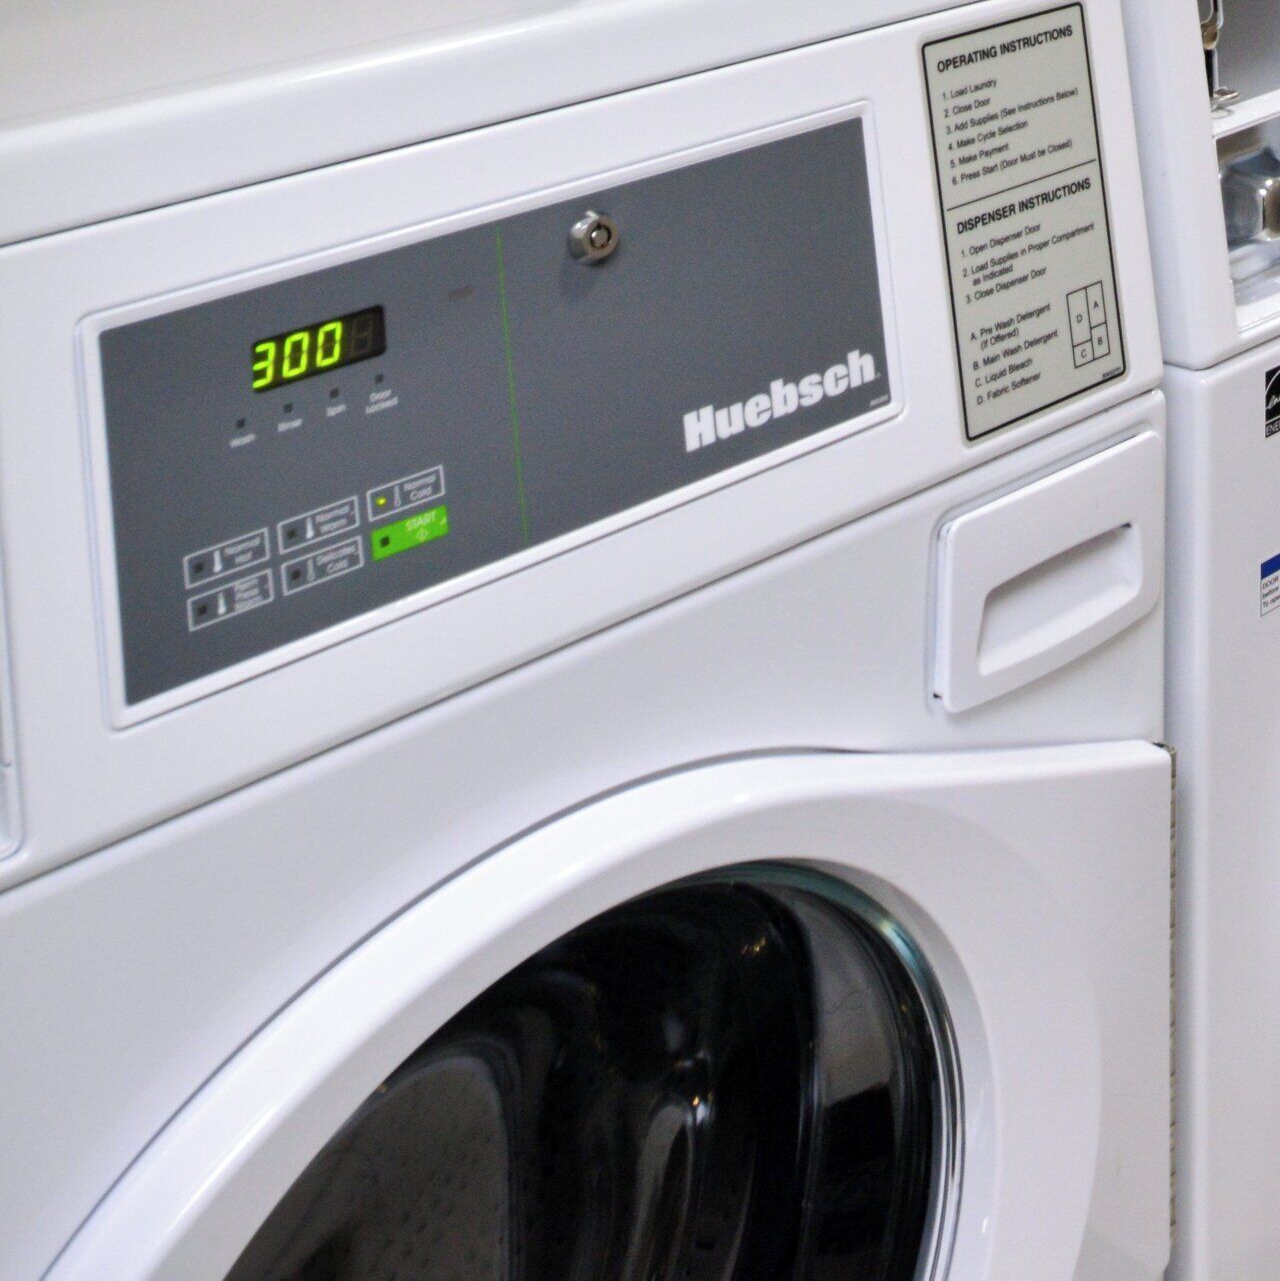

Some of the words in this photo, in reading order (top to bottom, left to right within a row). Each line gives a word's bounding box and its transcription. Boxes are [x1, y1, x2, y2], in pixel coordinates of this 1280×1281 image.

[936, 45, 997, 73] OPERATING
[999, 25, 1072, 55] INSTRUCTIONS
[951, 87, 967, 98] Load
[969, 78, 997, 94] Laundry
[952, 102, 972, 115] Close
[974, 97, 990, 108] Door
[954, 121, 968, 131] Add
[969, 111, 998, 128] Supplies
[1000, 106, 1016, 119] (See
[1017, 94, 1054, 112] Instructions
[1056, 87, 1078, 101] Below)
[957, 136, 975, 148] Make
[977, 129, 996, 144] Cycle
[998, 119, 1028, 135] Selection
[959, 153, 977, 165] Make
[979, 142, 1009, 160] Payment
[961, 169, 980, 182] Press
[982, 163, 998, 175] Start
[999, 157, 1018, 171] (Door
[1020, 151, 1035, 163] Must
[1037, 148, 1046, 157] be
[1047, 139, 1072, 155] Closed)
[957, 203, 1016, 234] DISPENSER
[1018, 177, 1091, 212] INSTRUCTIONS
[969, 242, 988, 257] Open
[989, 230, 1023, 250] Dispenser
[1024, 223, 1041, 236] Door
[971, 261, 988, 274] Load
[990, 250, 1018, 269] Supplies
[1020, 247, 1026, 256] in
[1028, 239, 1050, 255] Proper
[1051, 222, 1094, 246] Compartment
[972, 277, 980, 285] as
[982, 263, 1013, 281] Indicated
[974, 286, 993, 300] Close
[995, 273, 1029, 294] Dispenser
[1030, 266, 1047, 279] Door
[1092, 300, 1099, 310] A
[980, 326, 992, 337] Pre
[994, 317, 1014, 332] Wash
[1016, 303, 1050, 325] Detergent
[1076, 313, 1083, 323] D
[983, 353, 1000, 366] Main
[1002, 344, 1022, 359] Wash
[1023, 329, 1057, 351] Detergent
[990, 327, 1019, 347] Offered)
[1097, 336, 1103, 345] B
[252, 320, 343, 390] 300
[1080, 348, 1087, 358] C
[985, 368, 1006, 385] Liquid
[1008, 357, 1032, 374] Bleach
[987, 384, 1009, 400] Fabric
[1011, 371, 1040, 390] Softener
[681, 349, 876, 454] Huebsch
[409, 485, 433, 501] Cold
[405, 512, 437, 531] START
[1262, 575, 1278, 589] DOOR
[1262, 585, 1278, 598] before
[1262, 600, 1269, 608] To
